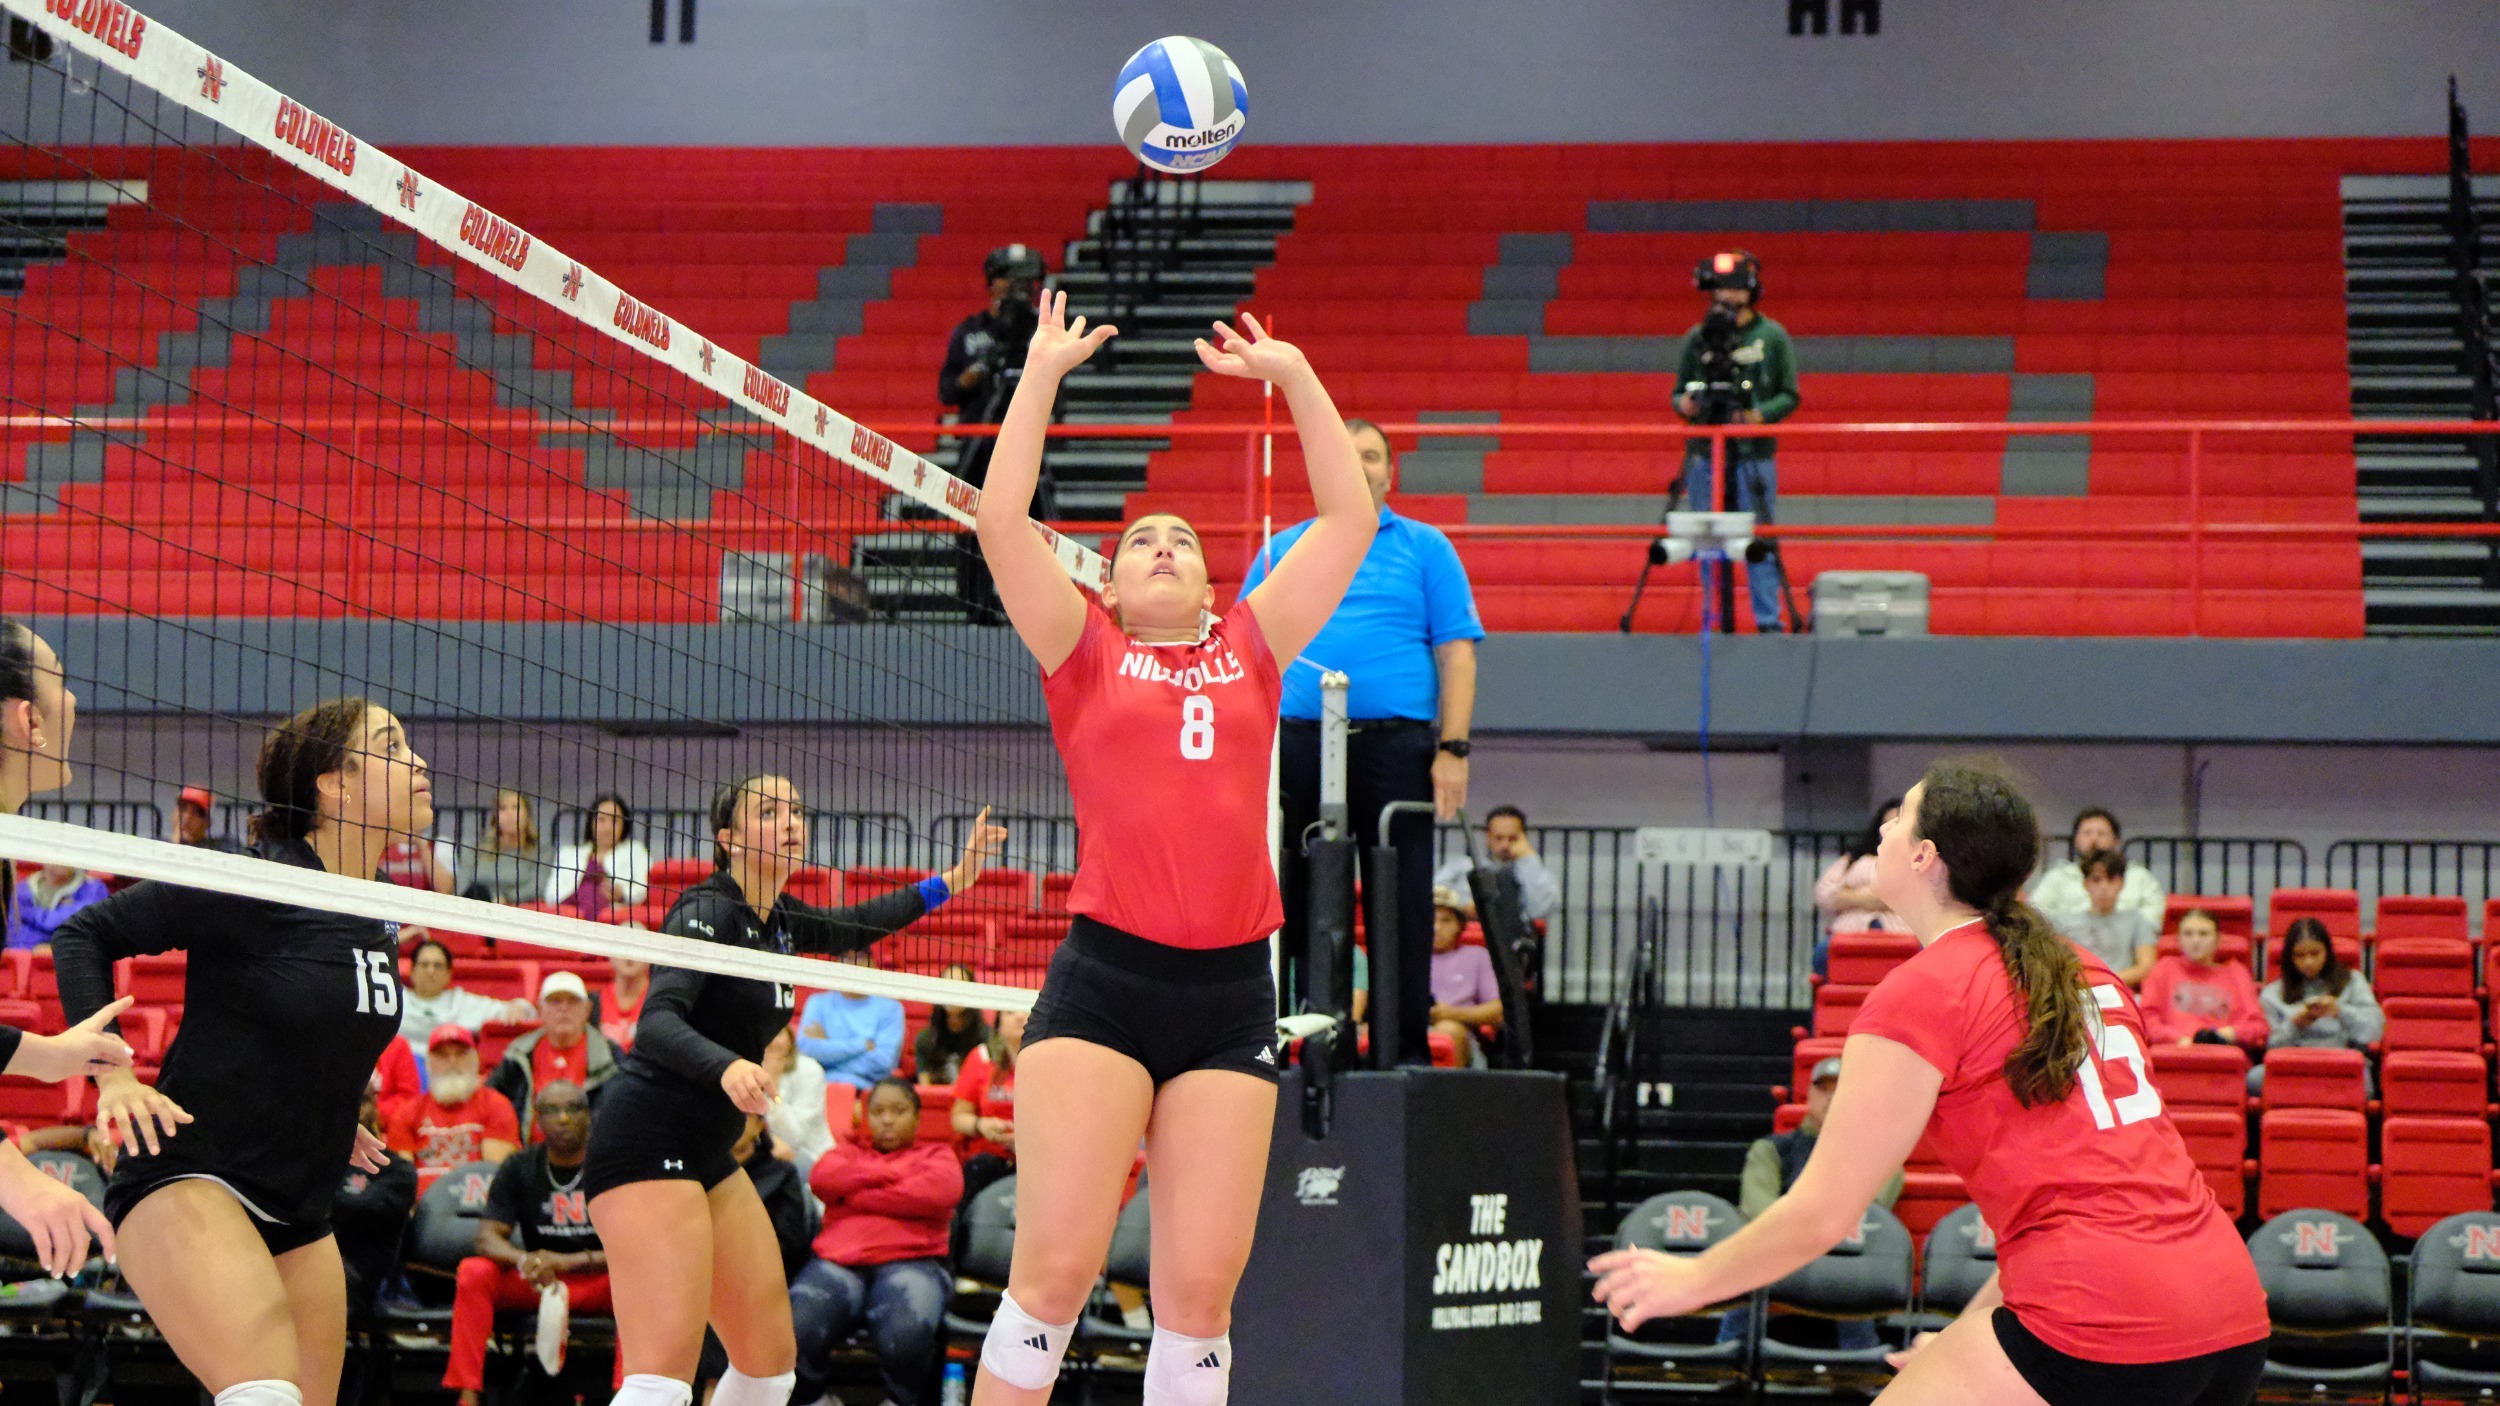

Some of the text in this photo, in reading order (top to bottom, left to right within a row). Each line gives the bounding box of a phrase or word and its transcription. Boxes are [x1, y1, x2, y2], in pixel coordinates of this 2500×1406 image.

[1165, 123, 1235, 147] molten
[274, 95, 357, 177] COLONELS
[459, 202, 530, 272] COLONELS
[613, 290, 671, 351] COLONELS
[743, 363, 790, 418] COLONELS
[1180, 695, 1214, 760] 8
[352, 948, 398, 1016] 15
[2077, 984, 2161, 1130] 15
[551, 1190, 586, 1225] N
[1470, 1193, 1507, 1235] THE
[1666, 1205, 1709, 1239] N
[2295, 1222, 2339, 1256] N
[1433, 1239, 1543, 1295] SANDBOX
